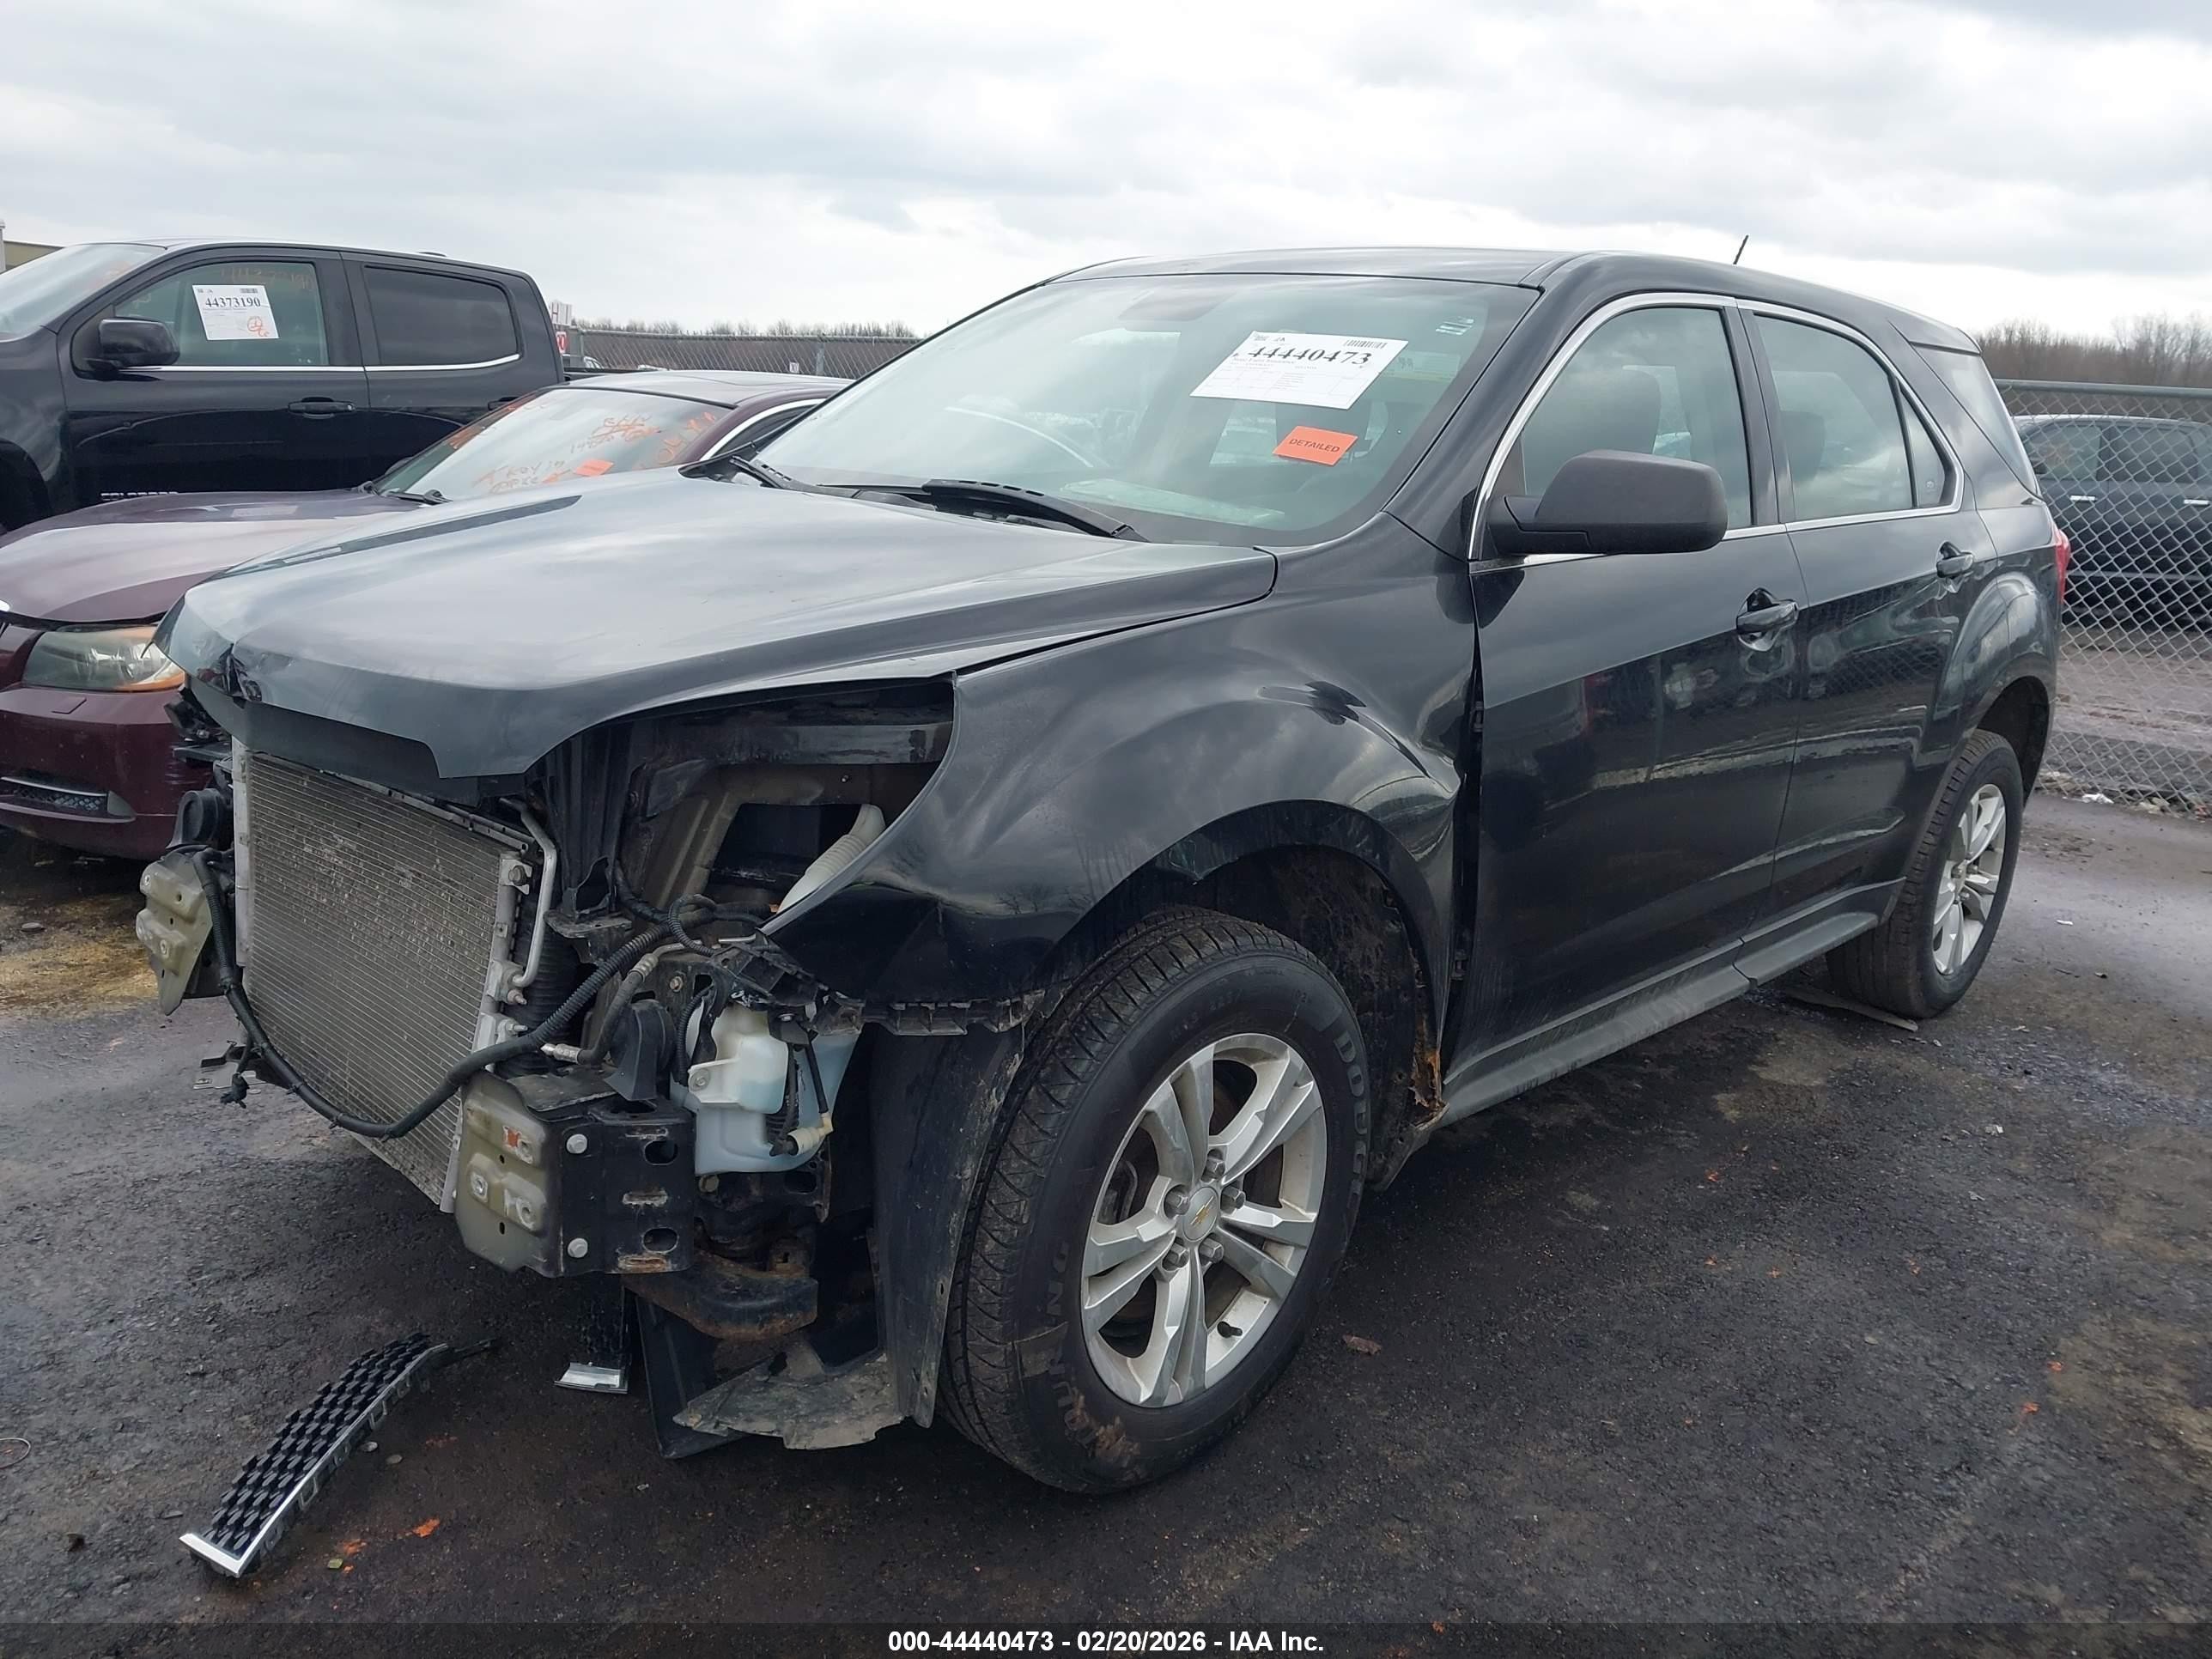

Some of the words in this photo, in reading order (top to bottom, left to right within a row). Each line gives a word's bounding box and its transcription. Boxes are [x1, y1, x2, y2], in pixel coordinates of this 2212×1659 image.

[205, 297, 261, 308] 44373190
[1248, 346, 1372, 365] 44440473
[1289, 438, 1341, 453] DETAILED
